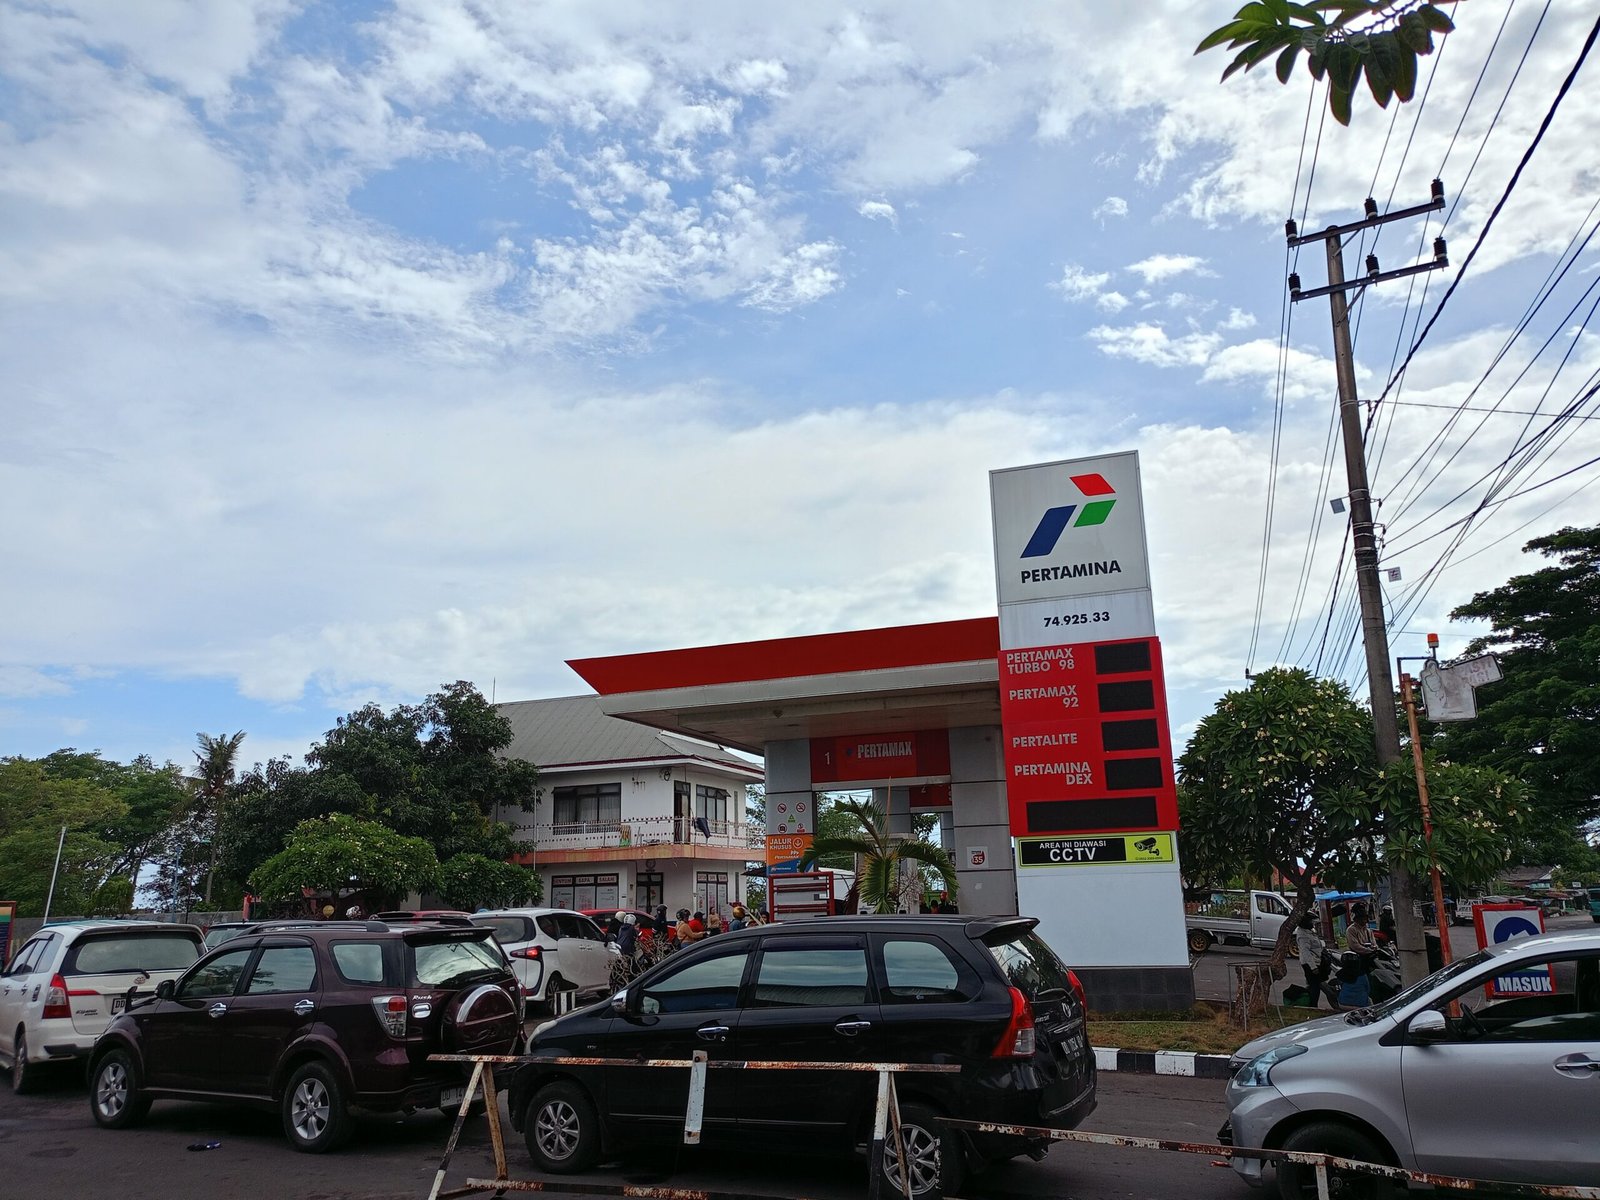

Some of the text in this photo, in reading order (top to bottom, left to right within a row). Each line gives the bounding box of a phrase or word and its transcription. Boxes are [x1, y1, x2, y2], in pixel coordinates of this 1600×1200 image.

[1020, 559, 1122, 584] PERTAMINA
[1043, 611, 1111, 628] 74.925.33
[1006, 647, 1074, 664] PERTAMAX
[1007, 659, 1075, 675] TURBO 98
[1008, 685, 1077, 701] PERTAMAX
[1062, 697, 1079, 709] 92
[1012, 732, 1078, 749] PERTALITE
[824, 751, 831, 765] 1
[857, 741, 913, 759] PERTAMAX
[1014, 761, 1092, 777] PERTAMINA
[1066, 773, 1093, 786] DEX
[1039, 841, 1061, 849] AREA
[1073, 840, 1107, 848] DIAWASI
[1049, 847, 1096, 862] CCTV
[1497, 976, 1553, 993] MASUK
[114, 1000, 126, 1009] DD
